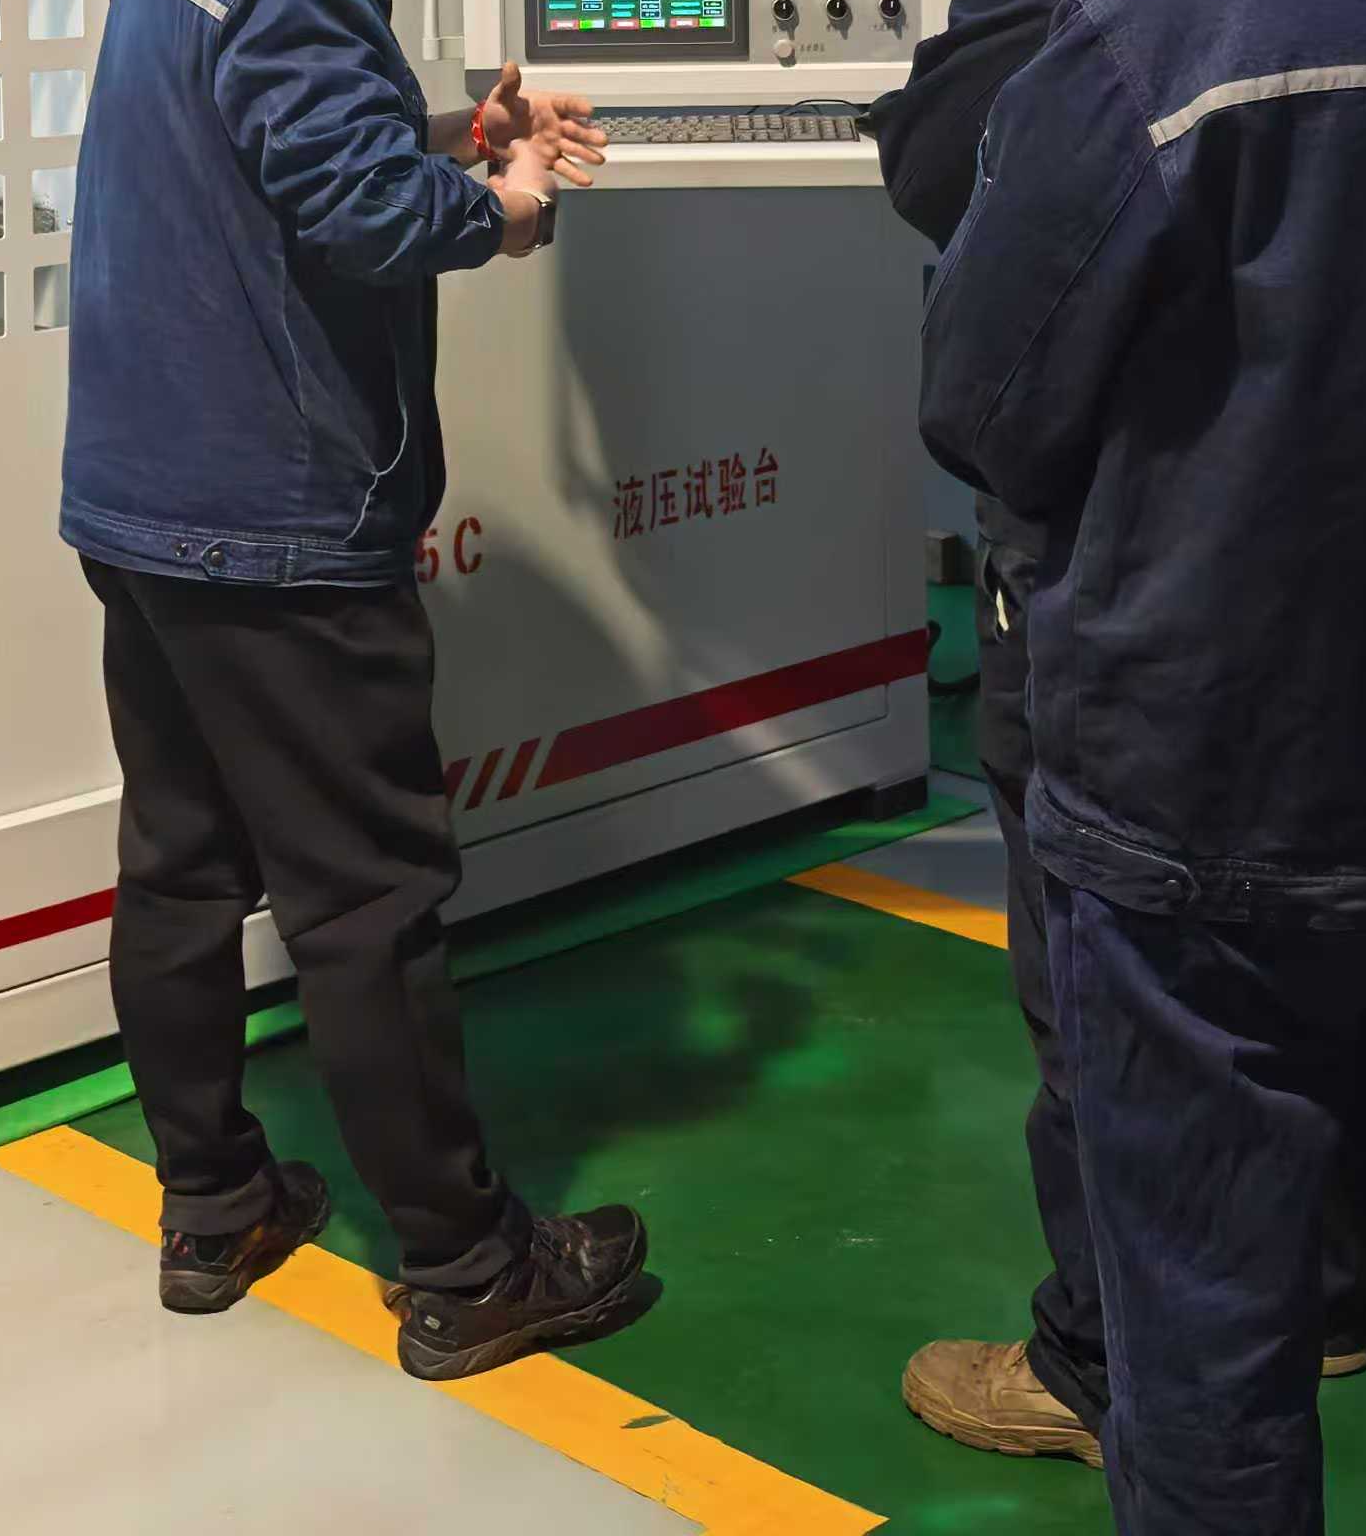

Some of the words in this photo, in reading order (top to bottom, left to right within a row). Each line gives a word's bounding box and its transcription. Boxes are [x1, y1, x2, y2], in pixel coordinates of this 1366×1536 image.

[613, 445, 780, 540] 液压试验台
